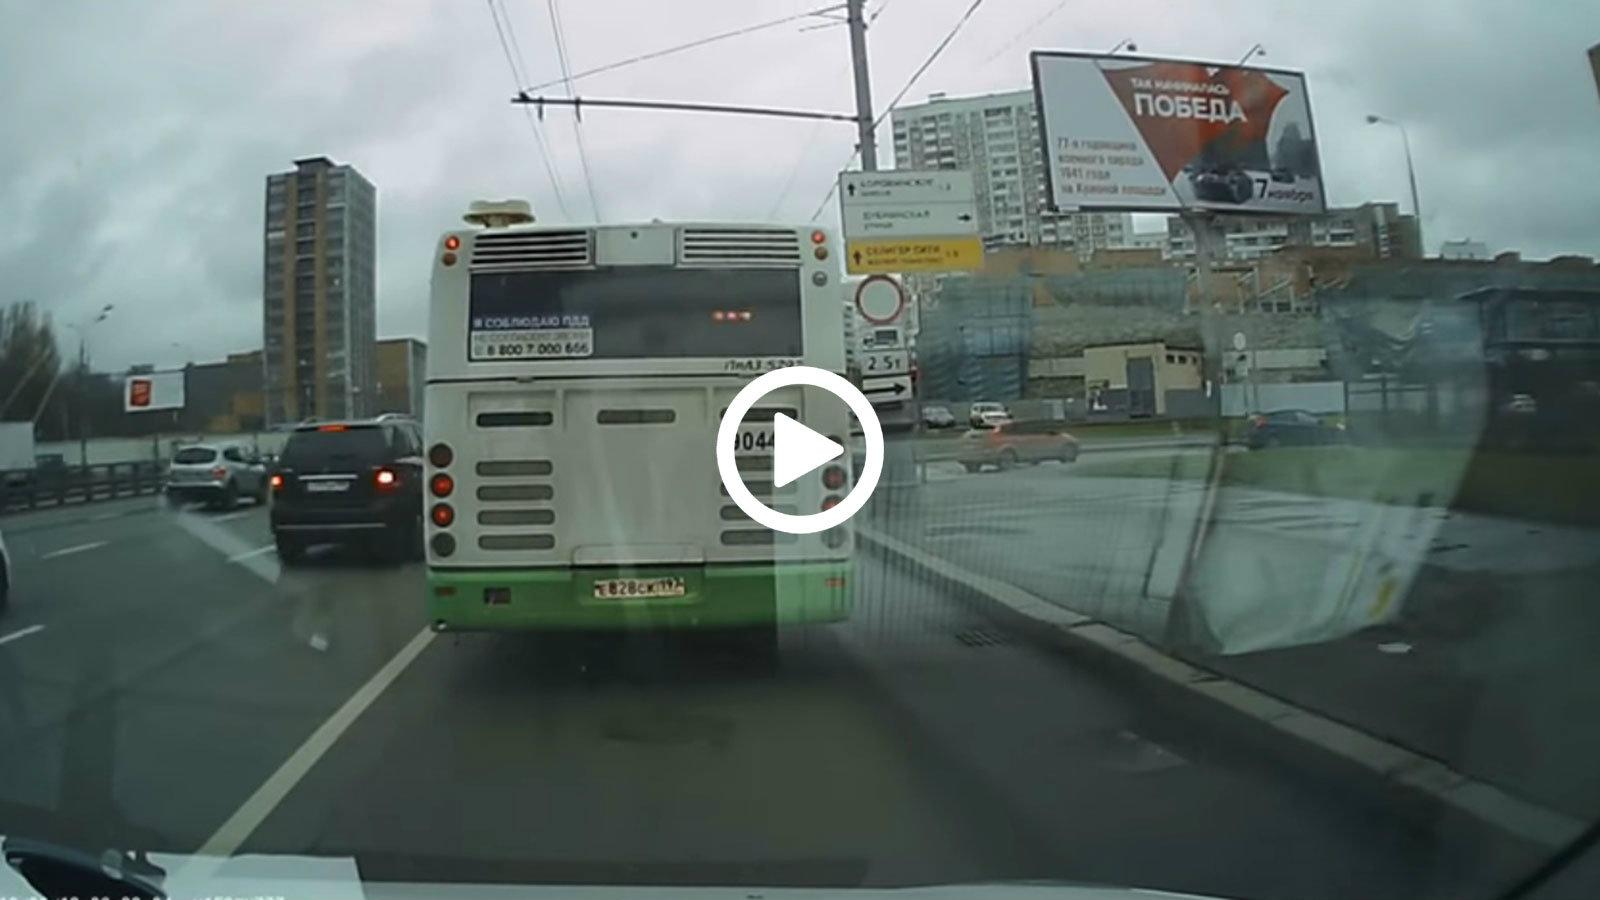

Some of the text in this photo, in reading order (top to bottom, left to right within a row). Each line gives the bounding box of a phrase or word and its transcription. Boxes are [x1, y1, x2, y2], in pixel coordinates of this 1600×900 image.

[1133, 92, 1248, 124] ПОБЕДА
[1254, 178, 1267, 199] 7
[499, 343, 523, 355] 800
[526, 343, 536, 353] 7
